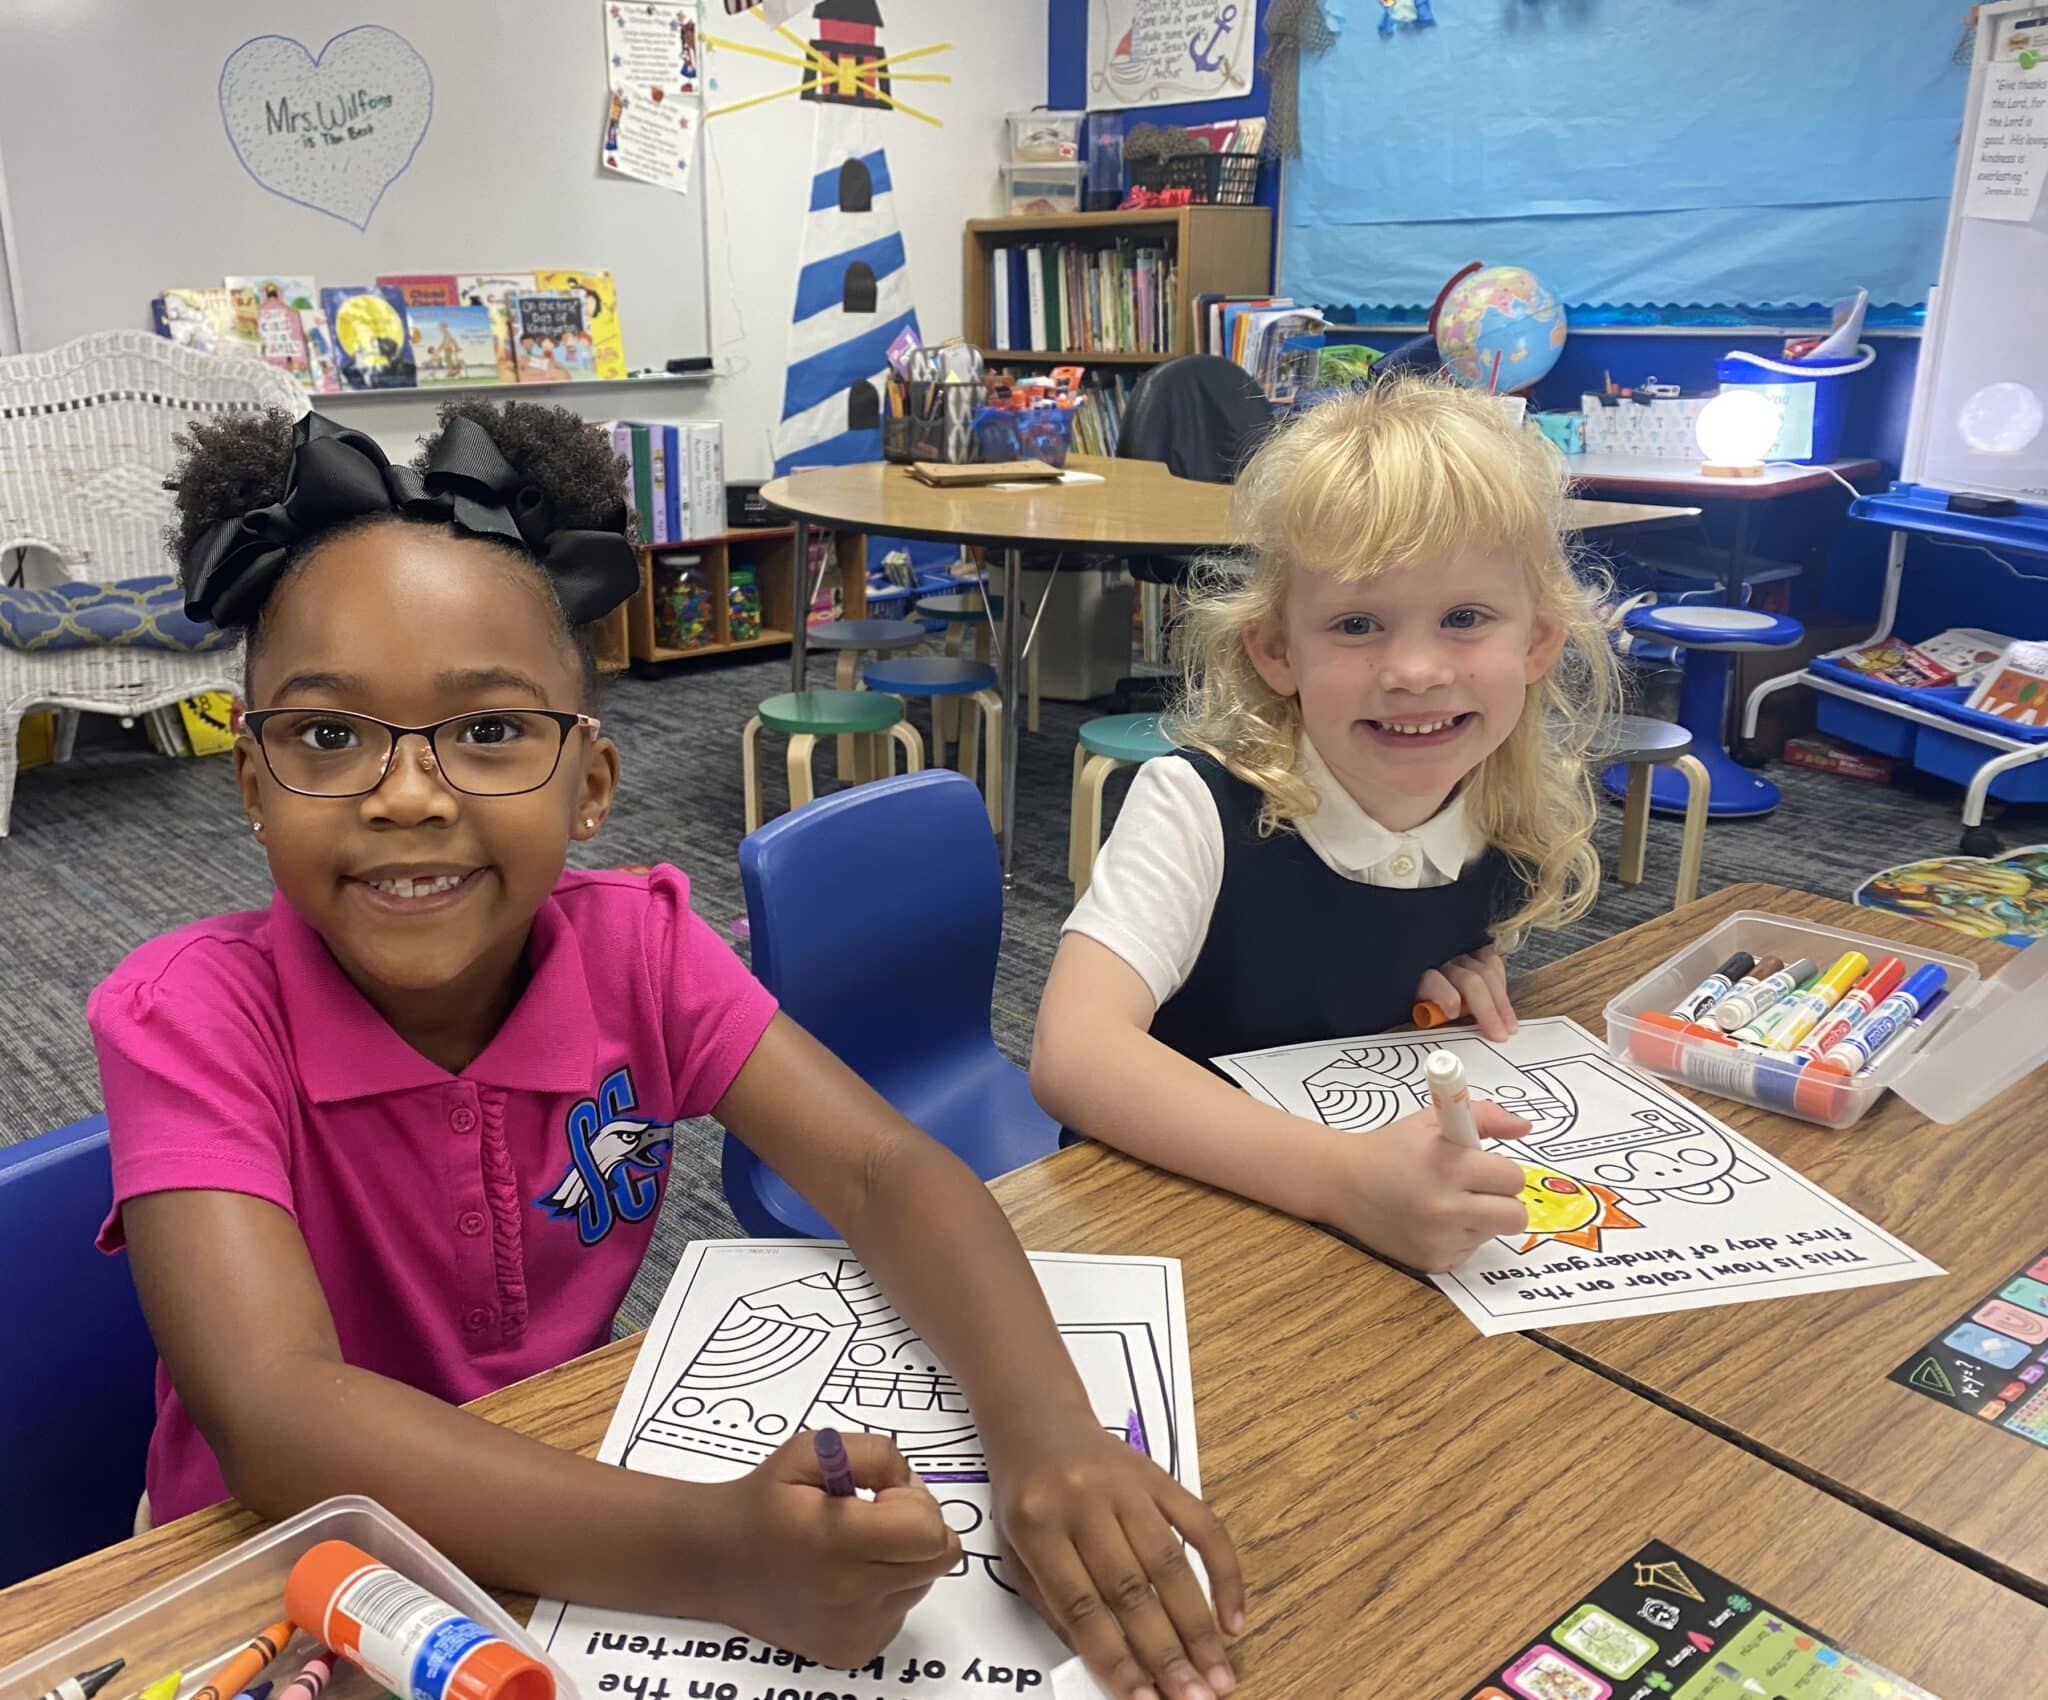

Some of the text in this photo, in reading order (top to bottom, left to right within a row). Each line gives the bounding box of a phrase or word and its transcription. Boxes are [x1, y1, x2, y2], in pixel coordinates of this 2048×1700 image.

[1160, 40, 1188, 54] Jesus
[265, 95, 318, 136] Mrs.
[1479, 1226, 1854, 1286] first day of kindergarten!
[1518, 1248, 1868, 1301] This is how I color on the
[585, 1631, 1043, 1693] day of kdergarten!
[599, 1673, 671, 1700] the
